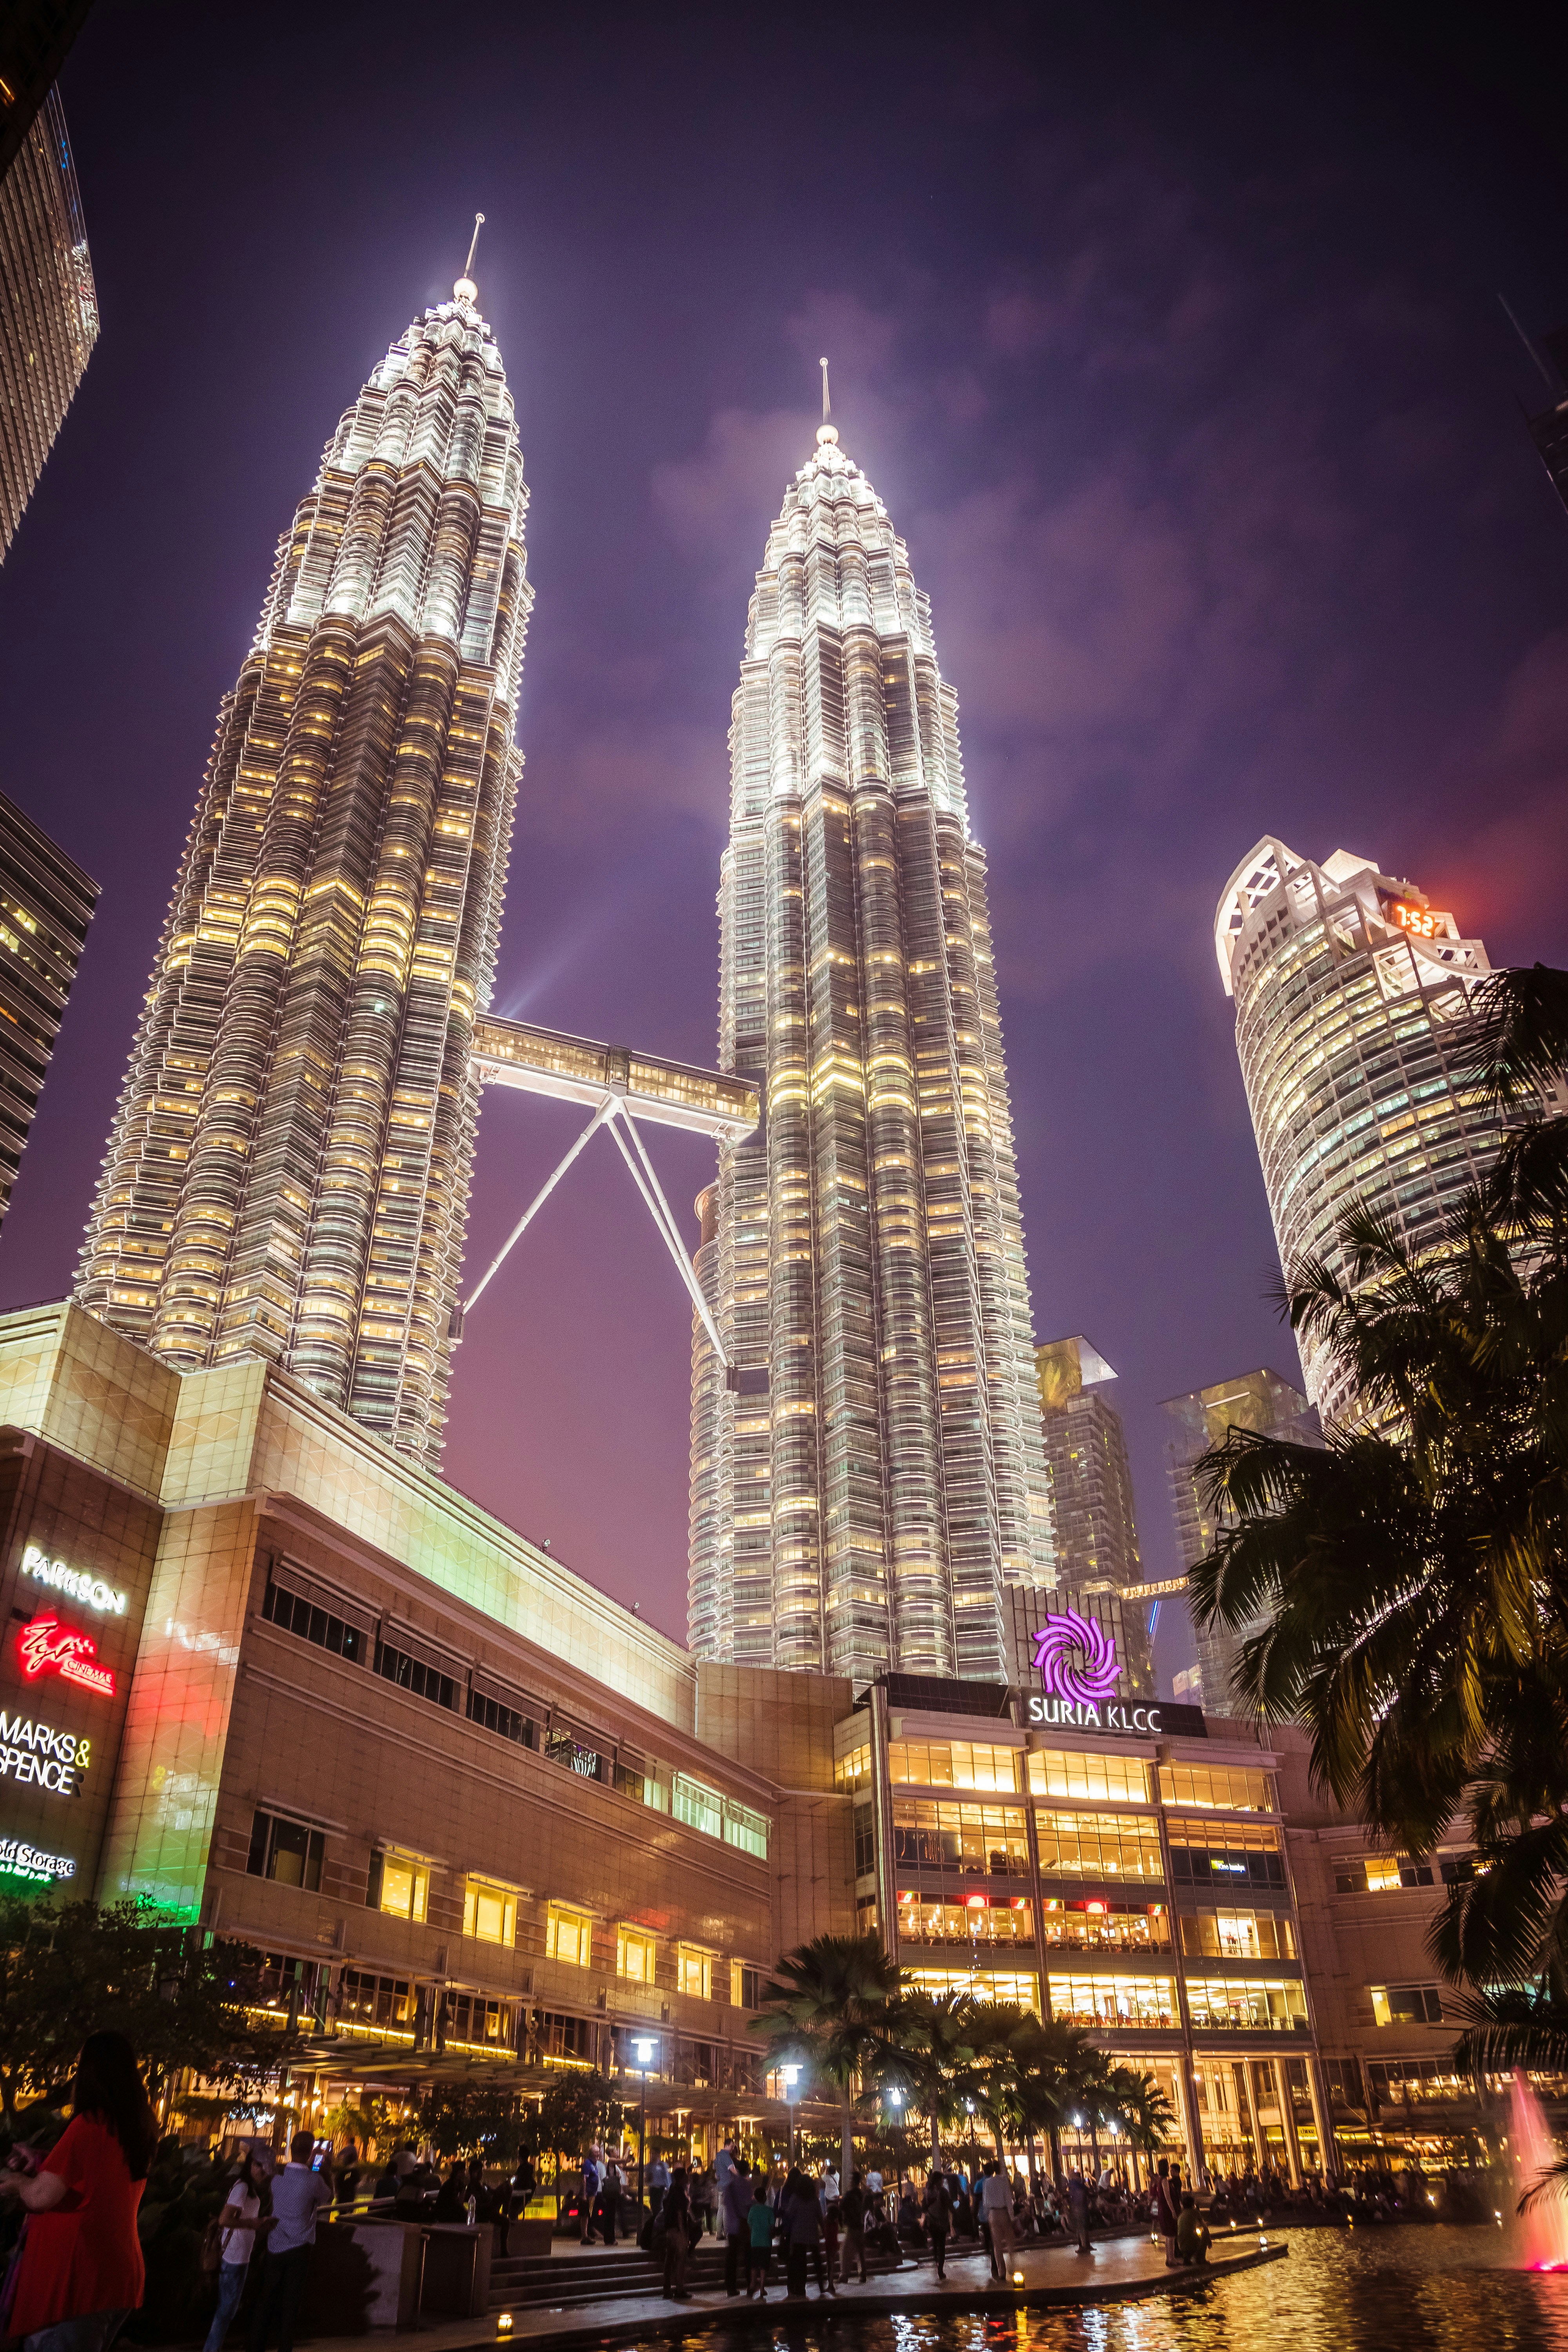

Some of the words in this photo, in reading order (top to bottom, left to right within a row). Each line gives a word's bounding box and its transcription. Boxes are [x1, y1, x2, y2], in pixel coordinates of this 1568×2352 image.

[1397, 905, 1433, 937] 7:52
[23, 1546, 125, 1615] PARKSON
[67, 1660, 113, 1684] CINEMAS
[1029, 1697, 1101, 1727] SURIA
[1108, 1705, 1162, 1732] KLCC
[0, 1711, 76, 1763] MARKS
[74, 1739, 91, 1769] &
[19, 1846, 76, 1876] Storage
